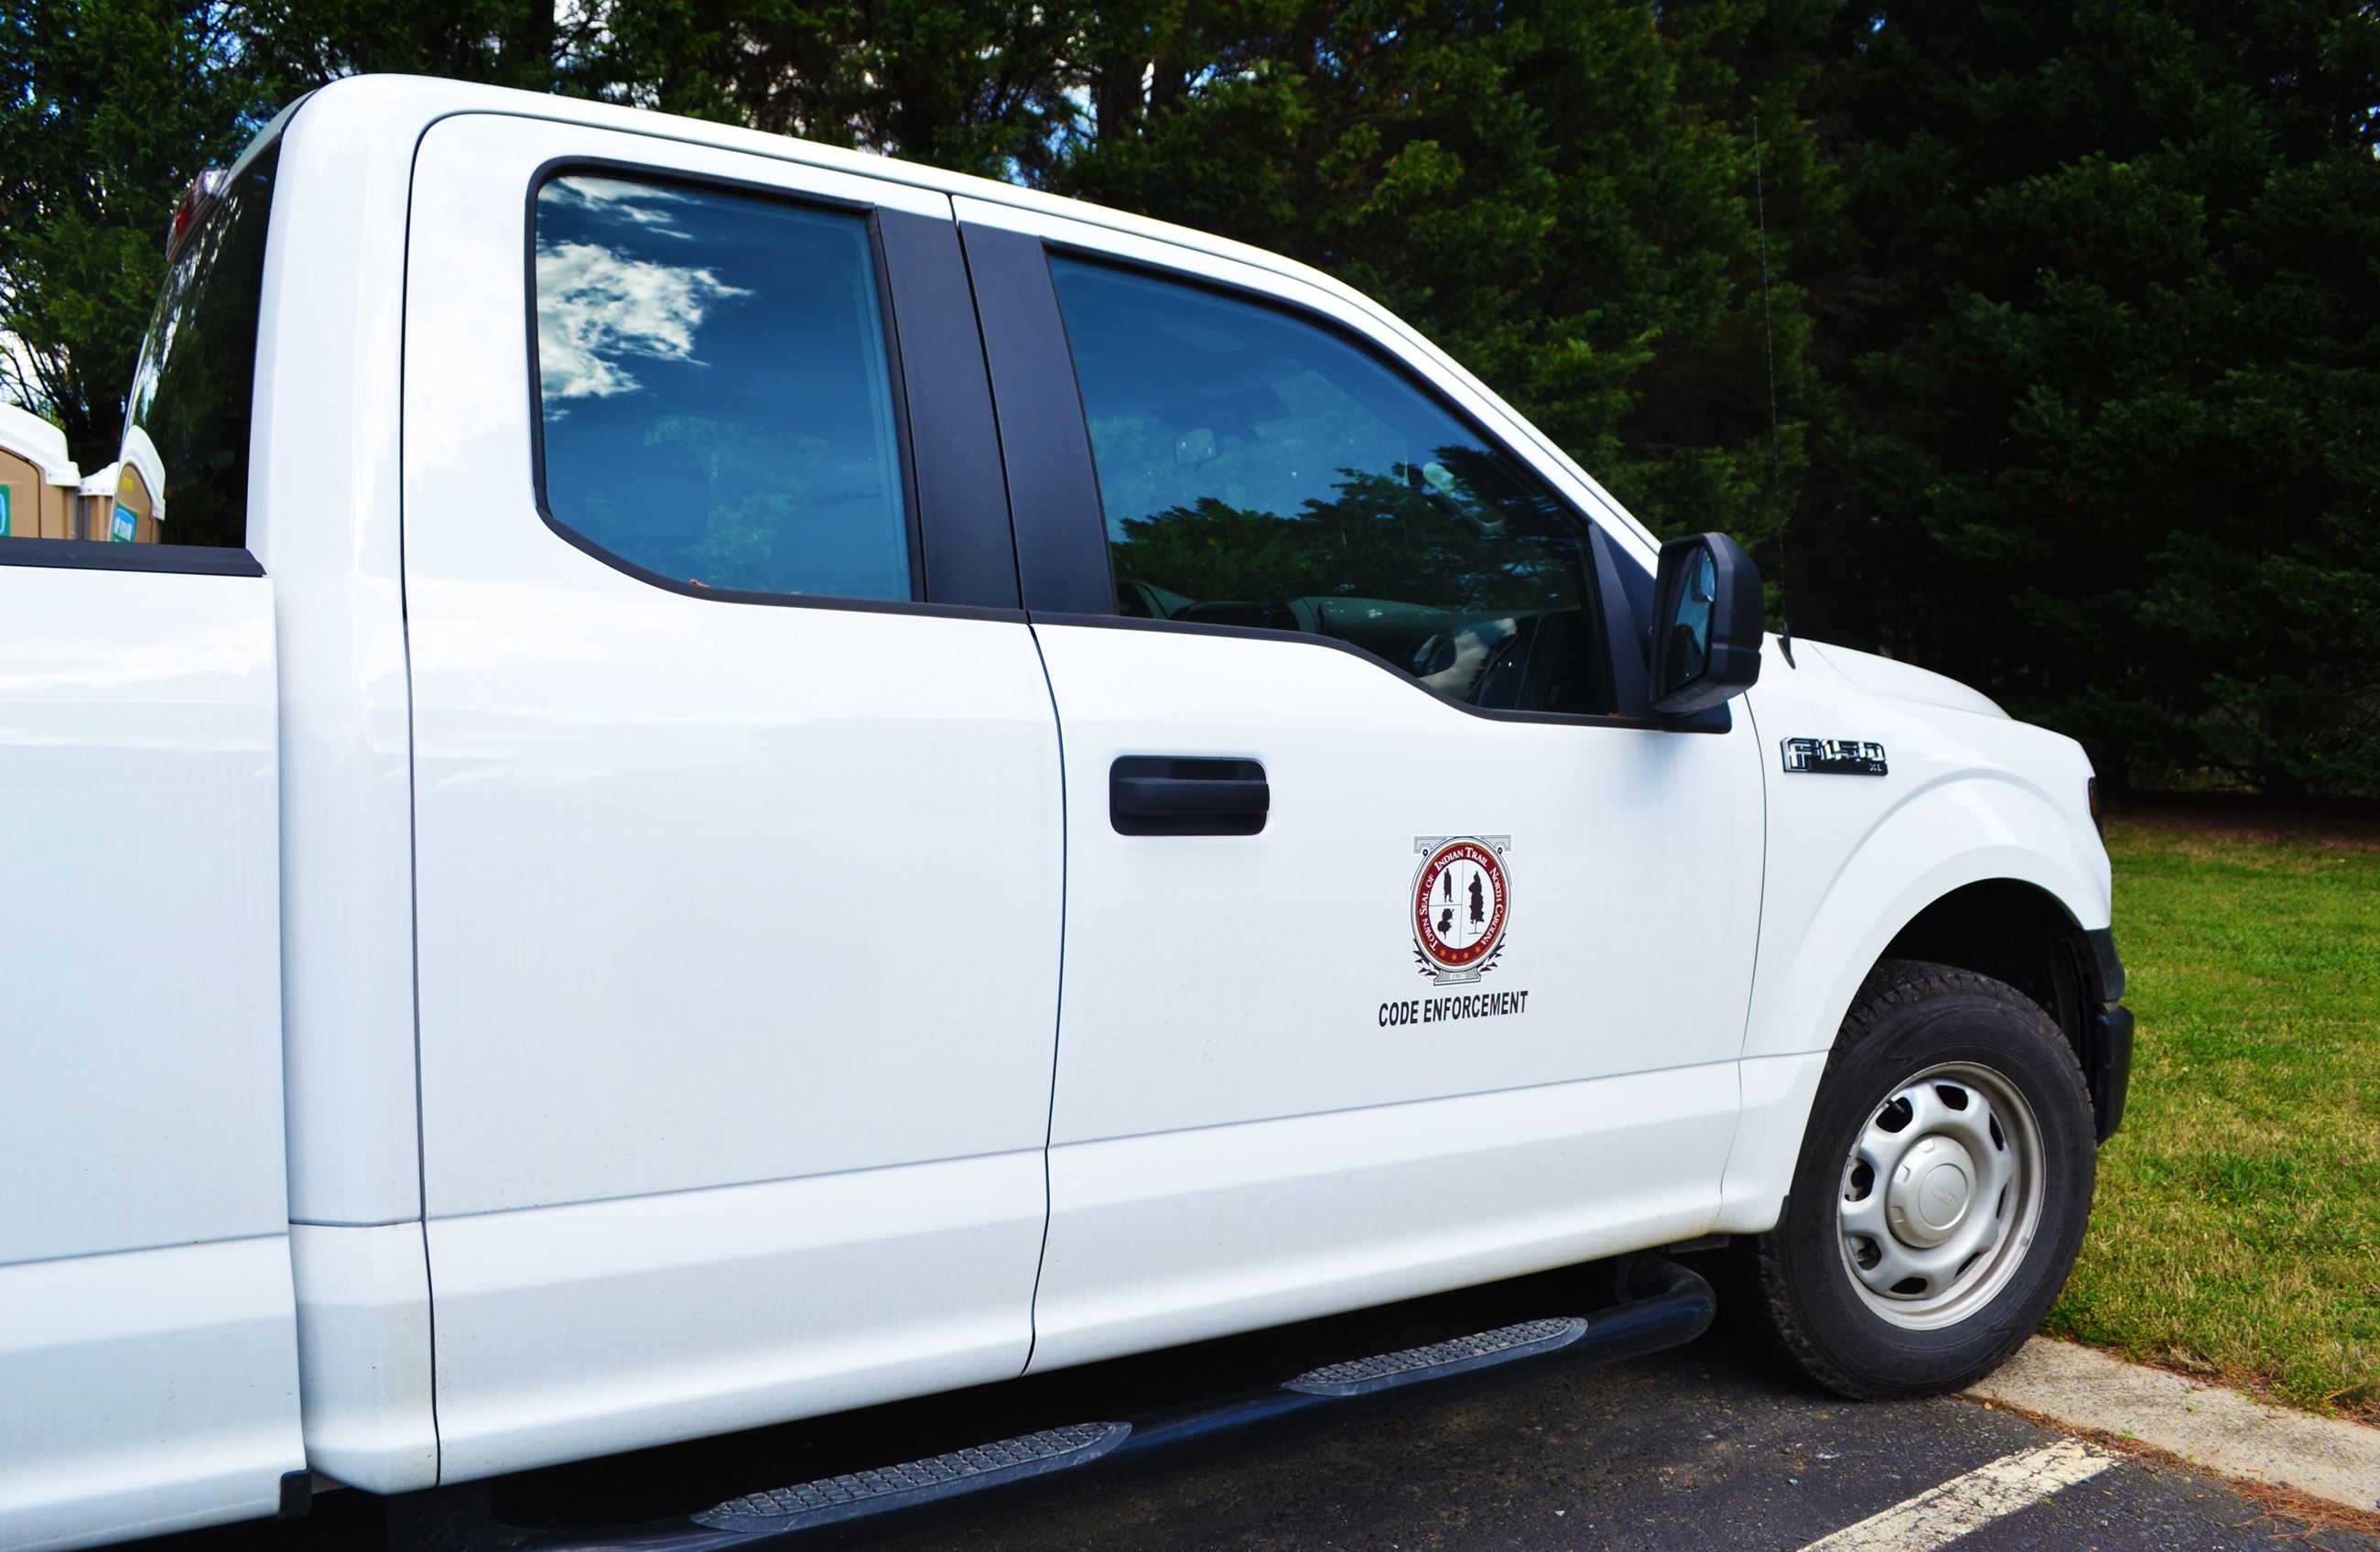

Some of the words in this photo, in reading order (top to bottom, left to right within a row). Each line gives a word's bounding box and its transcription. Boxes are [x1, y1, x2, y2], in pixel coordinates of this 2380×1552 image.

[1434, 849, 1464, 872] INDIAN
[1465, 846, 1488, 867] TRAIL
[1425, 874, 1433, 888] OF
[1489, 866, 1502, 902] NORTH
[1419, 890, 1429, 916] SEAL
[1422, 917, 1438, 950] TOWN
[1480, 904, 1504, 946] CAROLINA
[1379, 1000, 1419, 1027] CODE
[1423, 990, 1529, 1023] ENFORCEMENT
